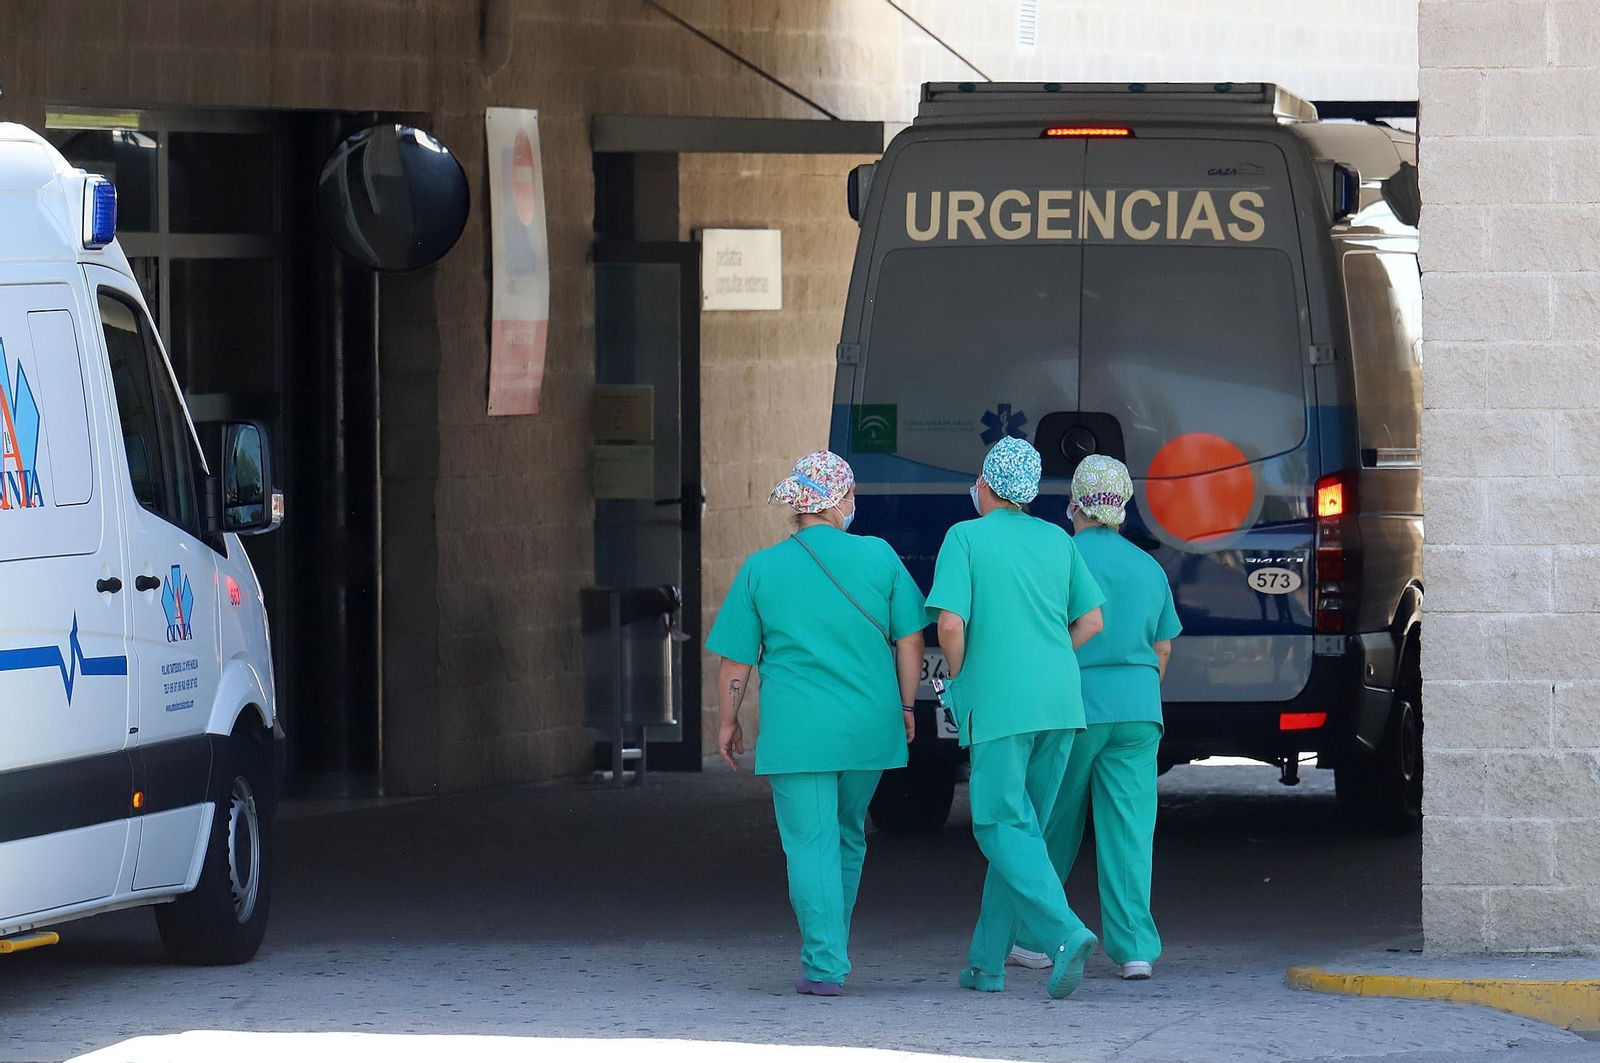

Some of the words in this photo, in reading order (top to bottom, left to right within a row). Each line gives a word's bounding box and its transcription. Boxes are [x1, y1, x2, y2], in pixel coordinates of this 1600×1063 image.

[1207, 168, 1238, 176] GAZA
[905, 189, 1266, 242] URGENCIAS
[1257, 573, 1291, 588] 573
[166, 623, 193, 643] CINTA
